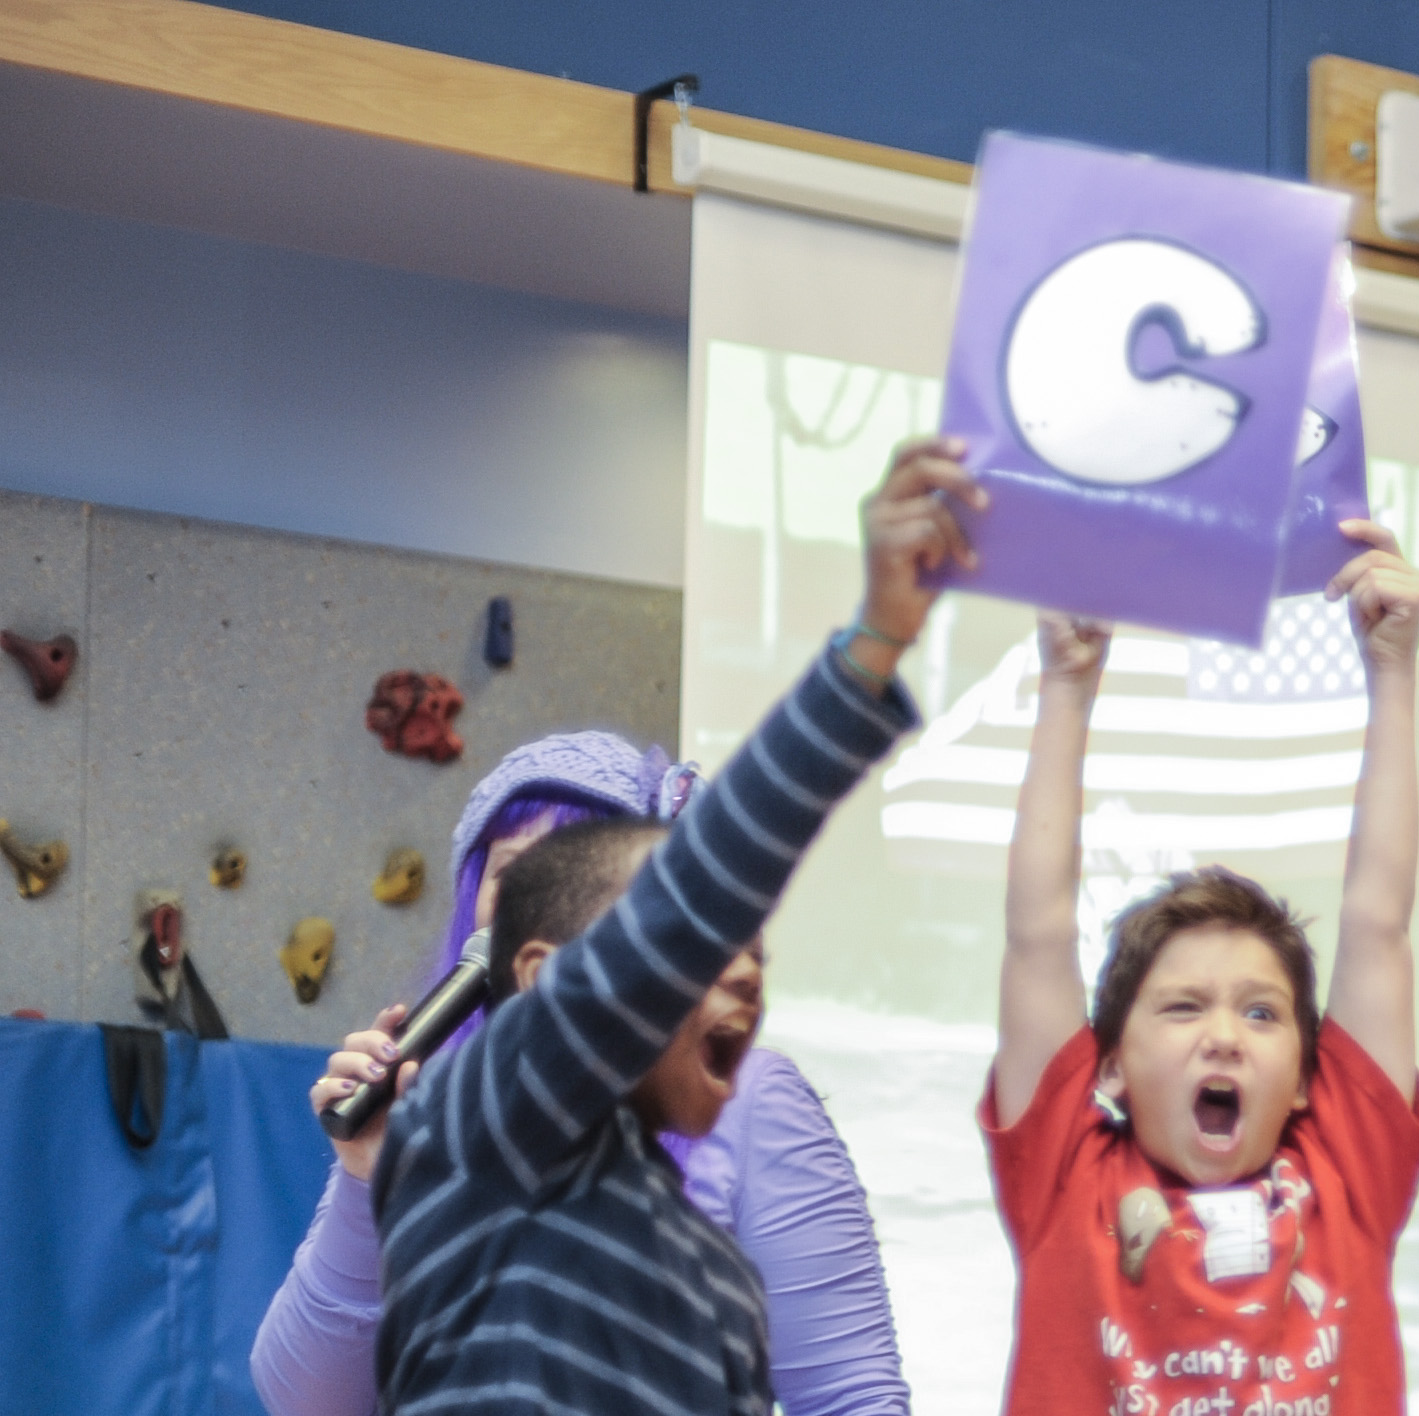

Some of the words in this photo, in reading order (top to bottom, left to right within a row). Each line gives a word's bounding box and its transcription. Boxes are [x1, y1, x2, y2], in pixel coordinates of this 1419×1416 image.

[998, 231, 1268, 487] C
[1164, 1339, 1249, 1380] can't
[1304, 1324, 1340, 1369] all
